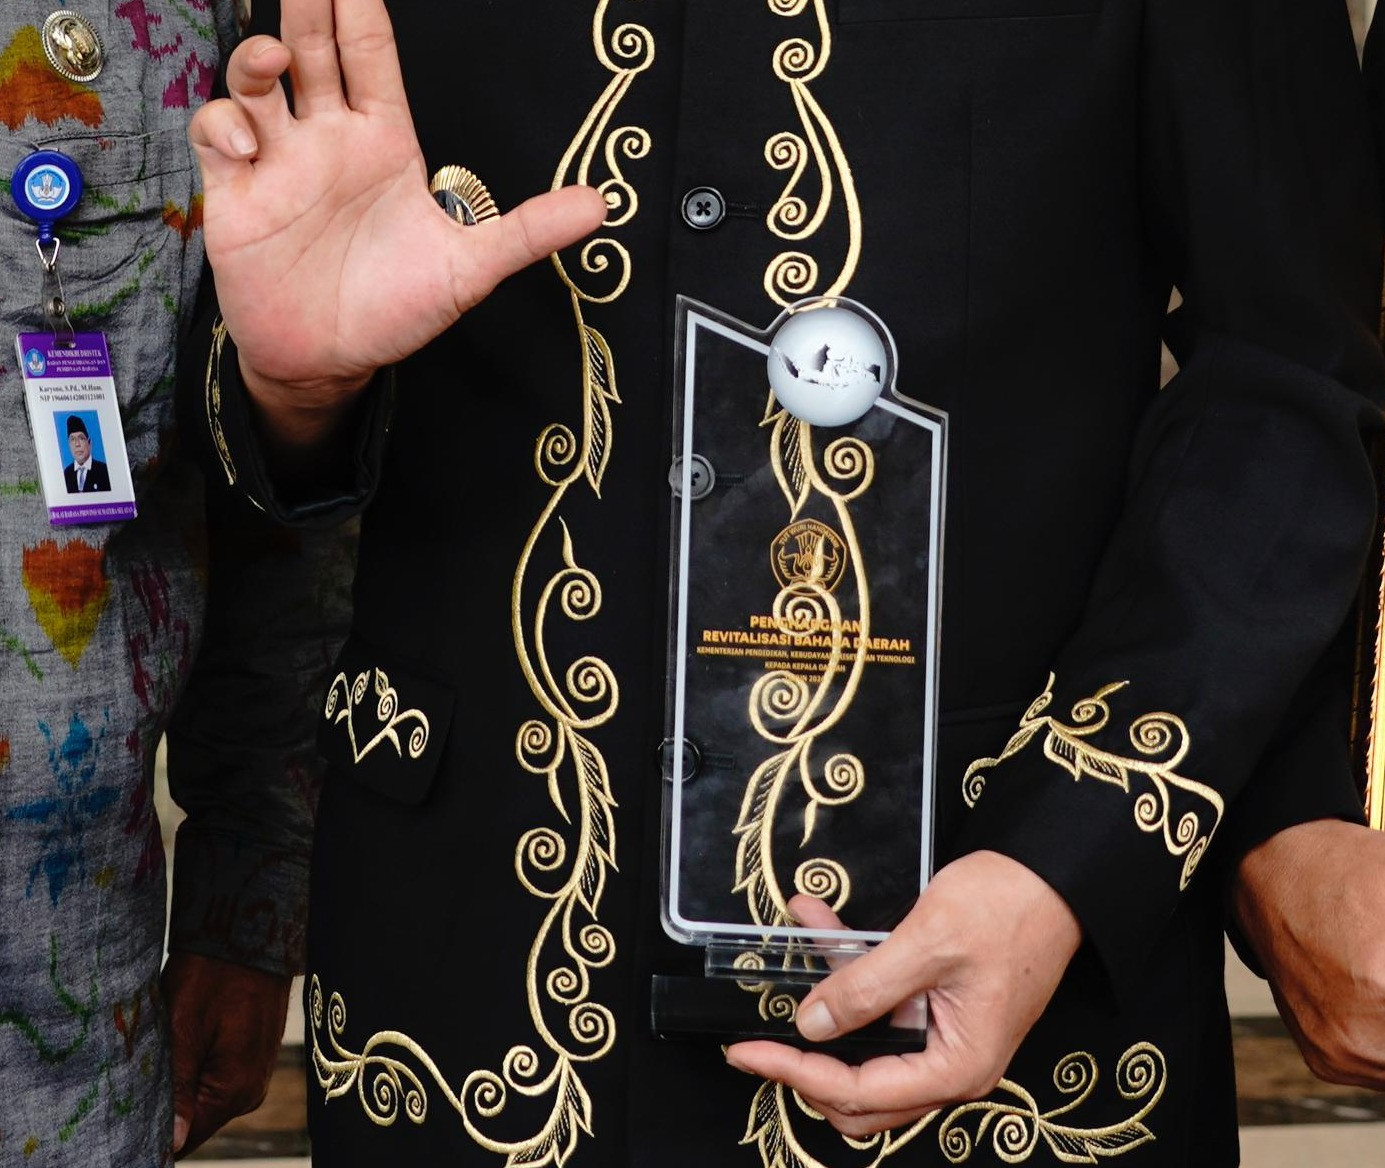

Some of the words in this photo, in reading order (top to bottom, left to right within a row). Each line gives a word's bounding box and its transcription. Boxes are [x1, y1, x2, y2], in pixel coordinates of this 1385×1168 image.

[703, 630, 791, 646] REVITALISASI
[697, 646, 744, 656] KEMENTERIAN
[876, 655, 915, 665] TEKNOLOGI
[765, 661, 790, 670] KEPADA
[792, 662, 817, 671] KEPALA
